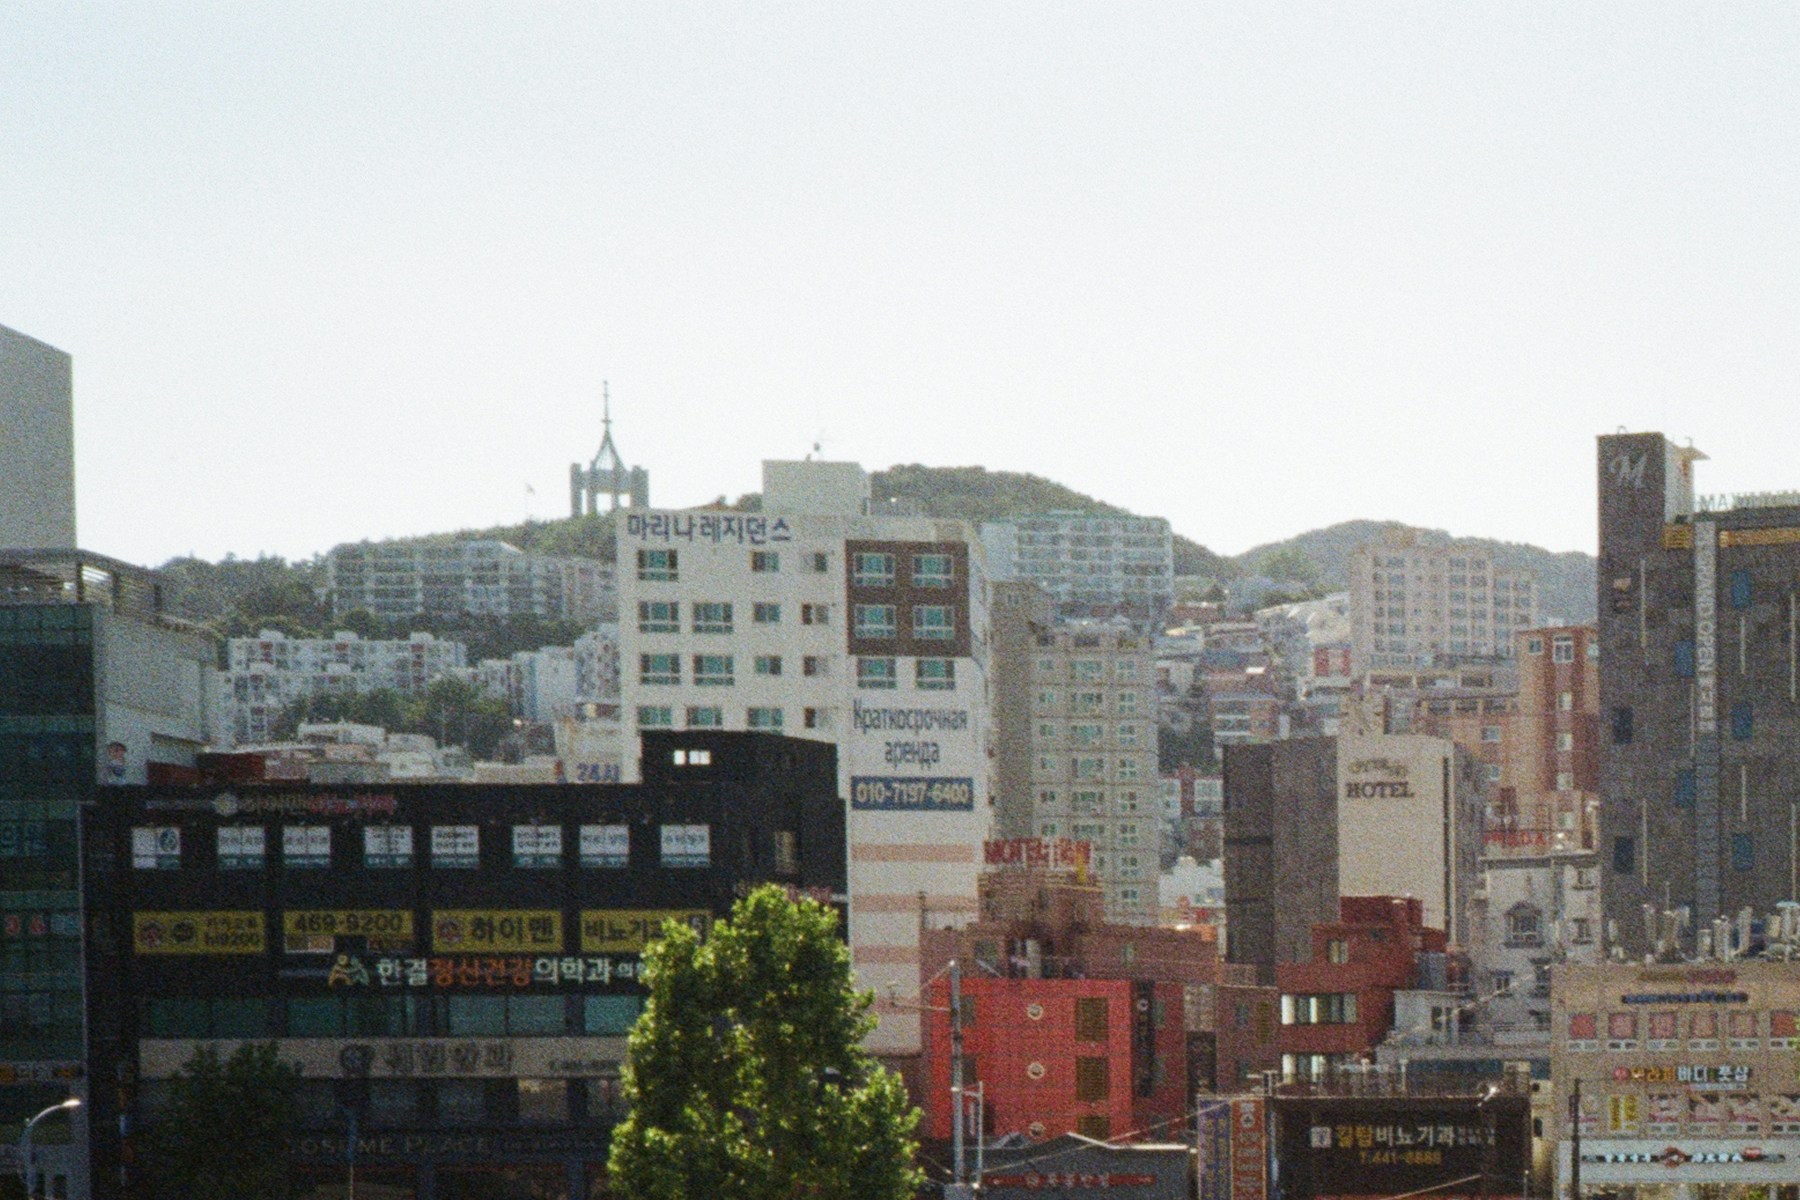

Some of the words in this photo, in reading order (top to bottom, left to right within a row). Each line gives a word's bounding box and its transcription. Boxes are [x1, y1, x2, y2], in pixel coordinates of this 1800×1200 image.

[627, 514, 791, 545] 마리나레지던스
[853, 699, 967, 734] Краткосрочная
[885, 742, 939, 769] аренда
[1346, 781, 1415, 799] HOTEL
[294, 914, 404, 932] 469-9200
[471, 915, 554, 944] 하이맨
[376, 957, 611, 986] 한결정신건강의학과
